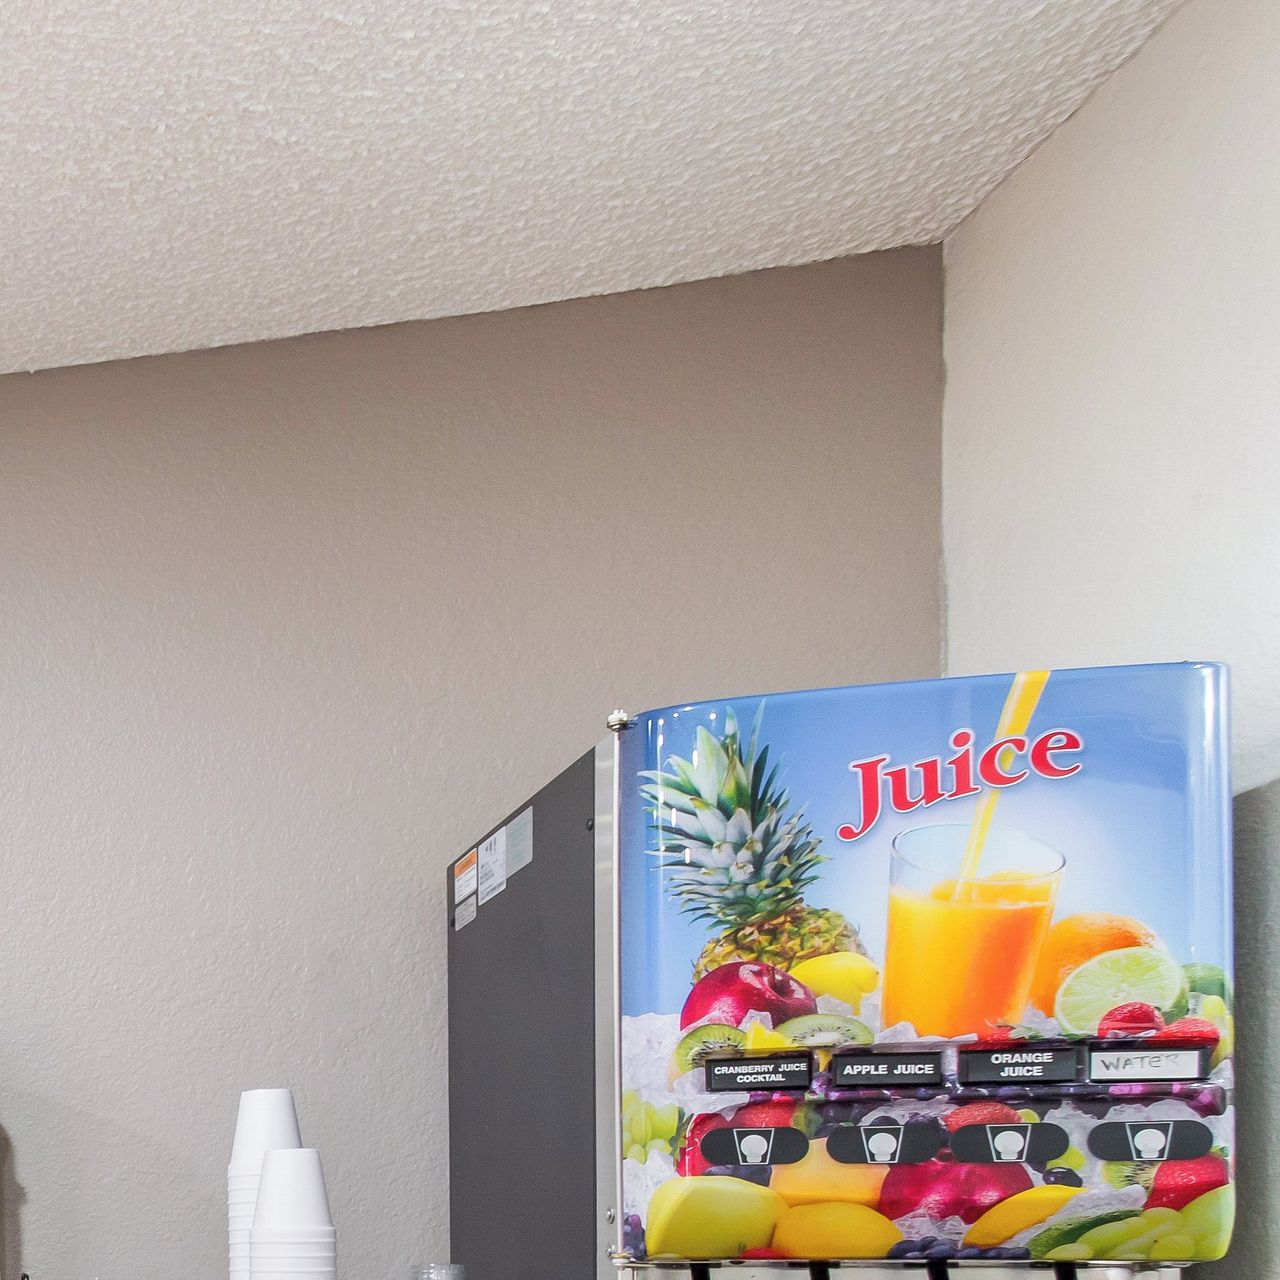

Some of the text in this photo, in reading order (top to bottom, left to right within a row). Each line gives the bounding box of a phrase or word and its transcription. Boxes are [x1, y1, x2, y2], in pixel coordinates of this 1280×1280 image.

[837, 729, 1082, 841] Juice
[991, 1052, 1054, 1064] ORANGE
[714, 1062, 808, 1075] CRANBERRY JUICE
[843, 1063, 934, 1075] APPLE JUICE
[1000, 1066, 1044, 1077] JUICE
[736, 1074, 786, 1083] COCKTAIL
